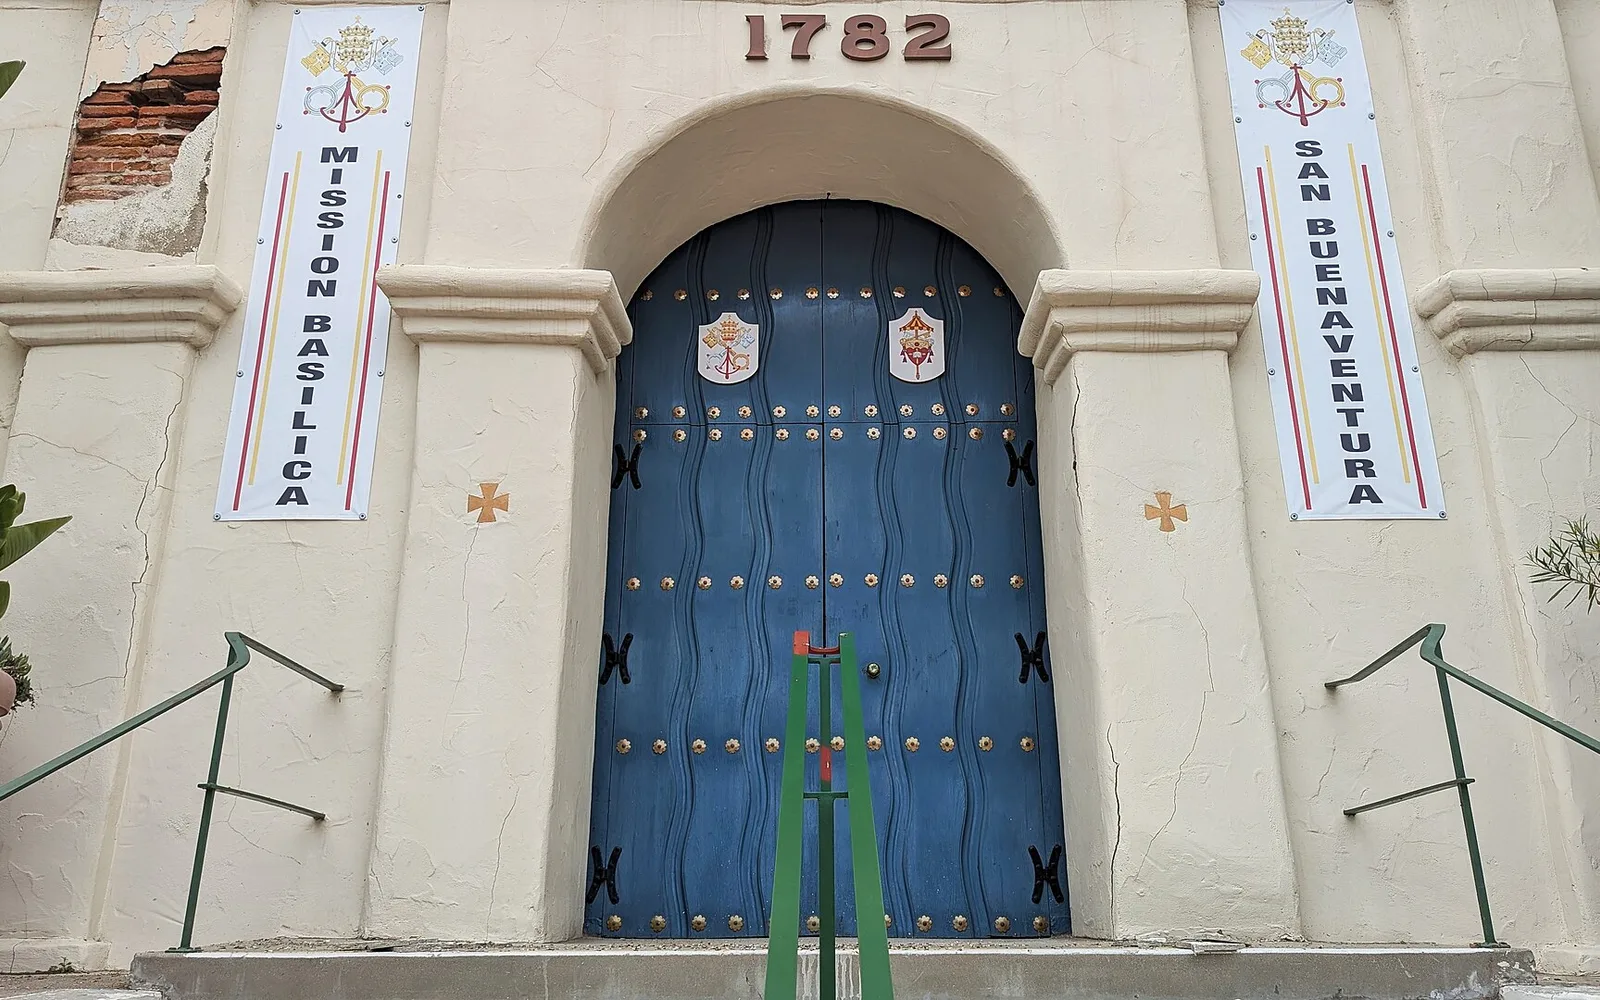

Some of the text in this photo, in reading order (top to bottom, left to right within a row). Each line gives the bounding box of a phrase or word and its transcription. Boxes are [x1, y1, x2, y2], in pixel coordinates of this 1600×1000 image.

[745, 14, 952, 61] 1782
[275, 146, 359, 506] MISSION BASILICA
[1295, 140, 1383, 504] SAN BUENAVENTURA
